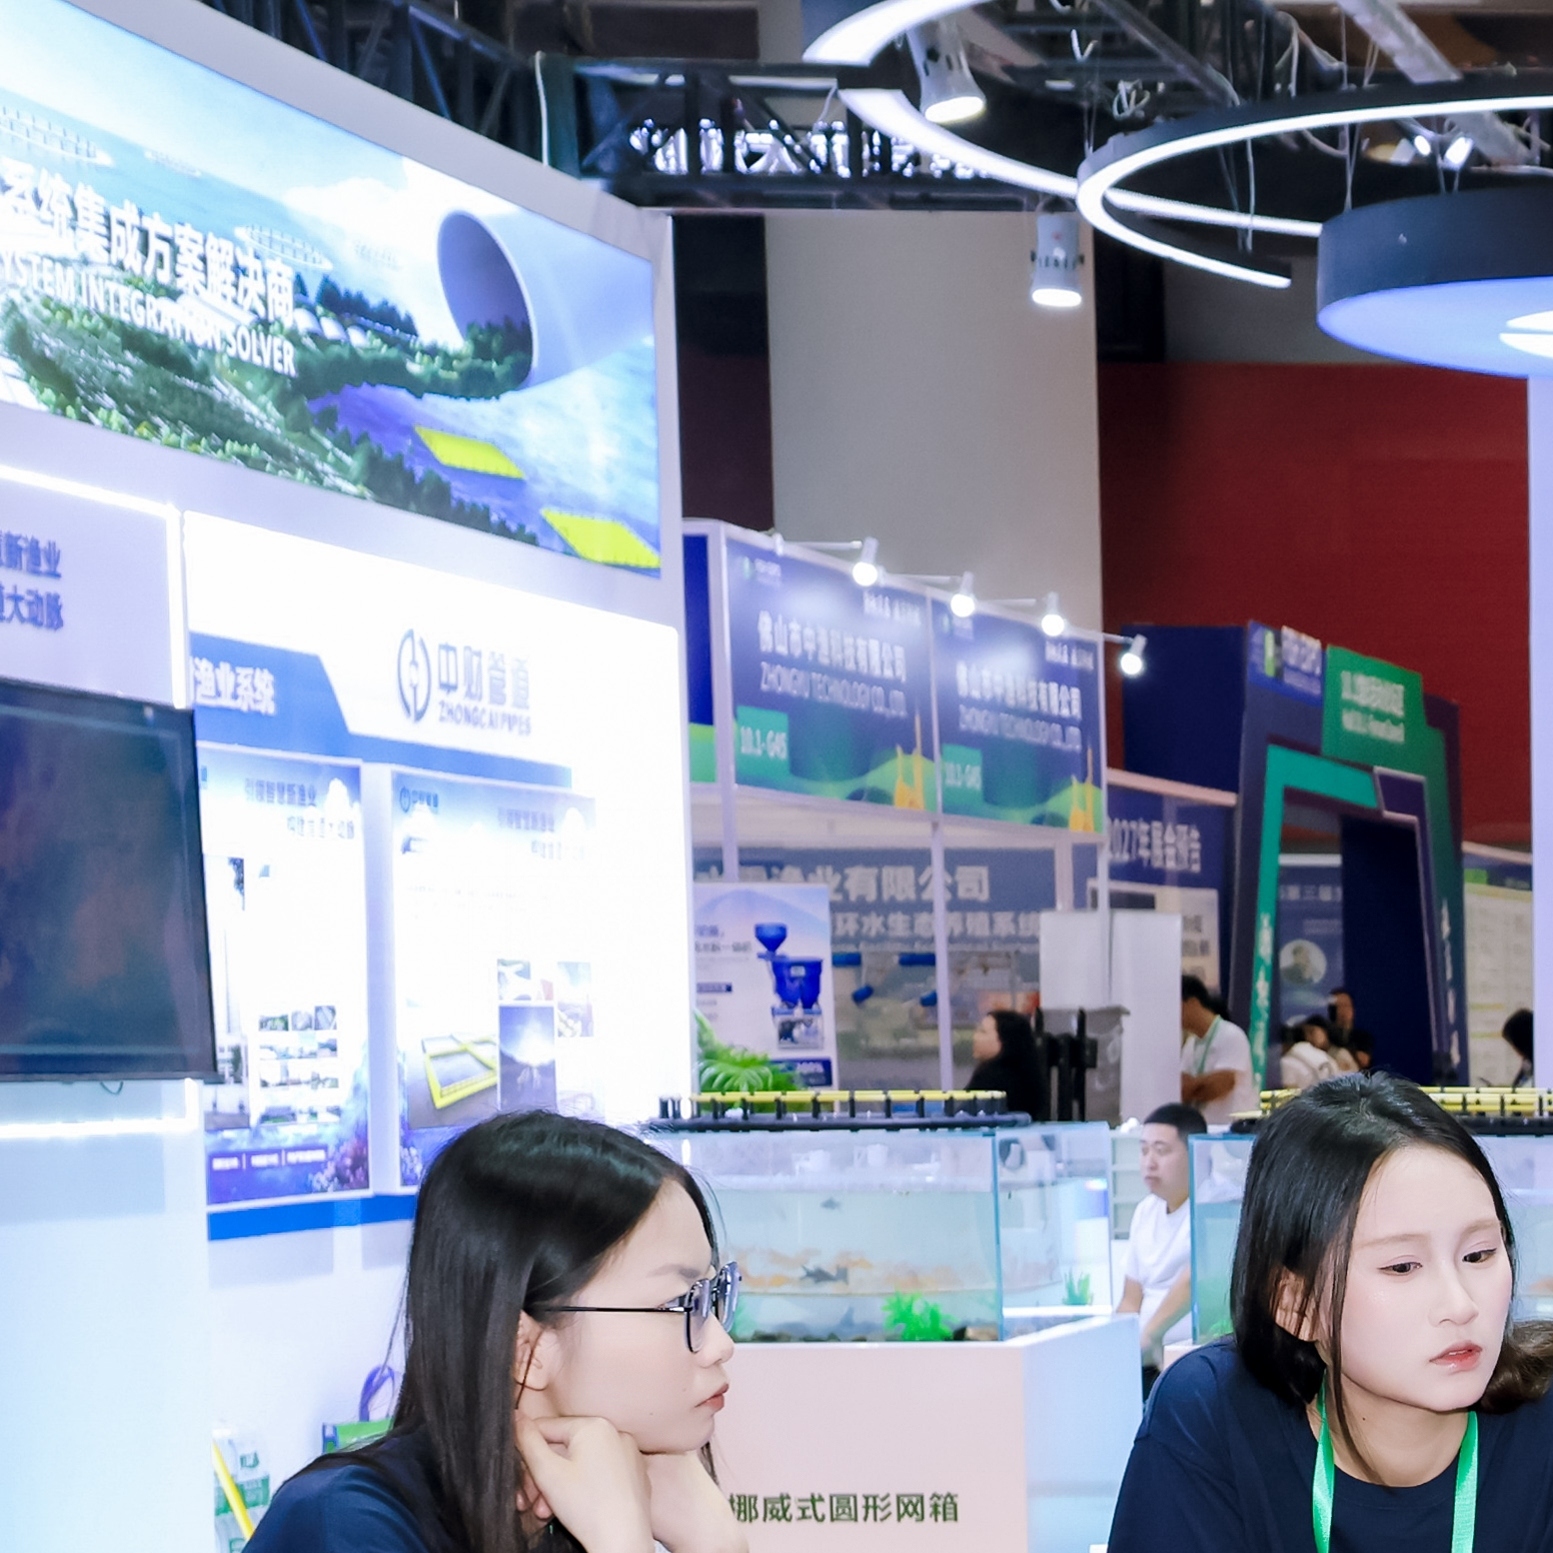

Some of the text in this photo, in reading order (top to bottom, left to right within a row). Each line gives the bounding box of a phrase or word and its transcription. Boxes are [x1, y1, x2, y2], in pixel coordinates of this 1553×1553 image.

[226, 324, 298, 378] SOLVER
[0, 530, 61, 579] 新渔业
[0, 581, 63, 631] 大动脉
[728, 1491, 958, 1523] 挪威式圆形网箱
